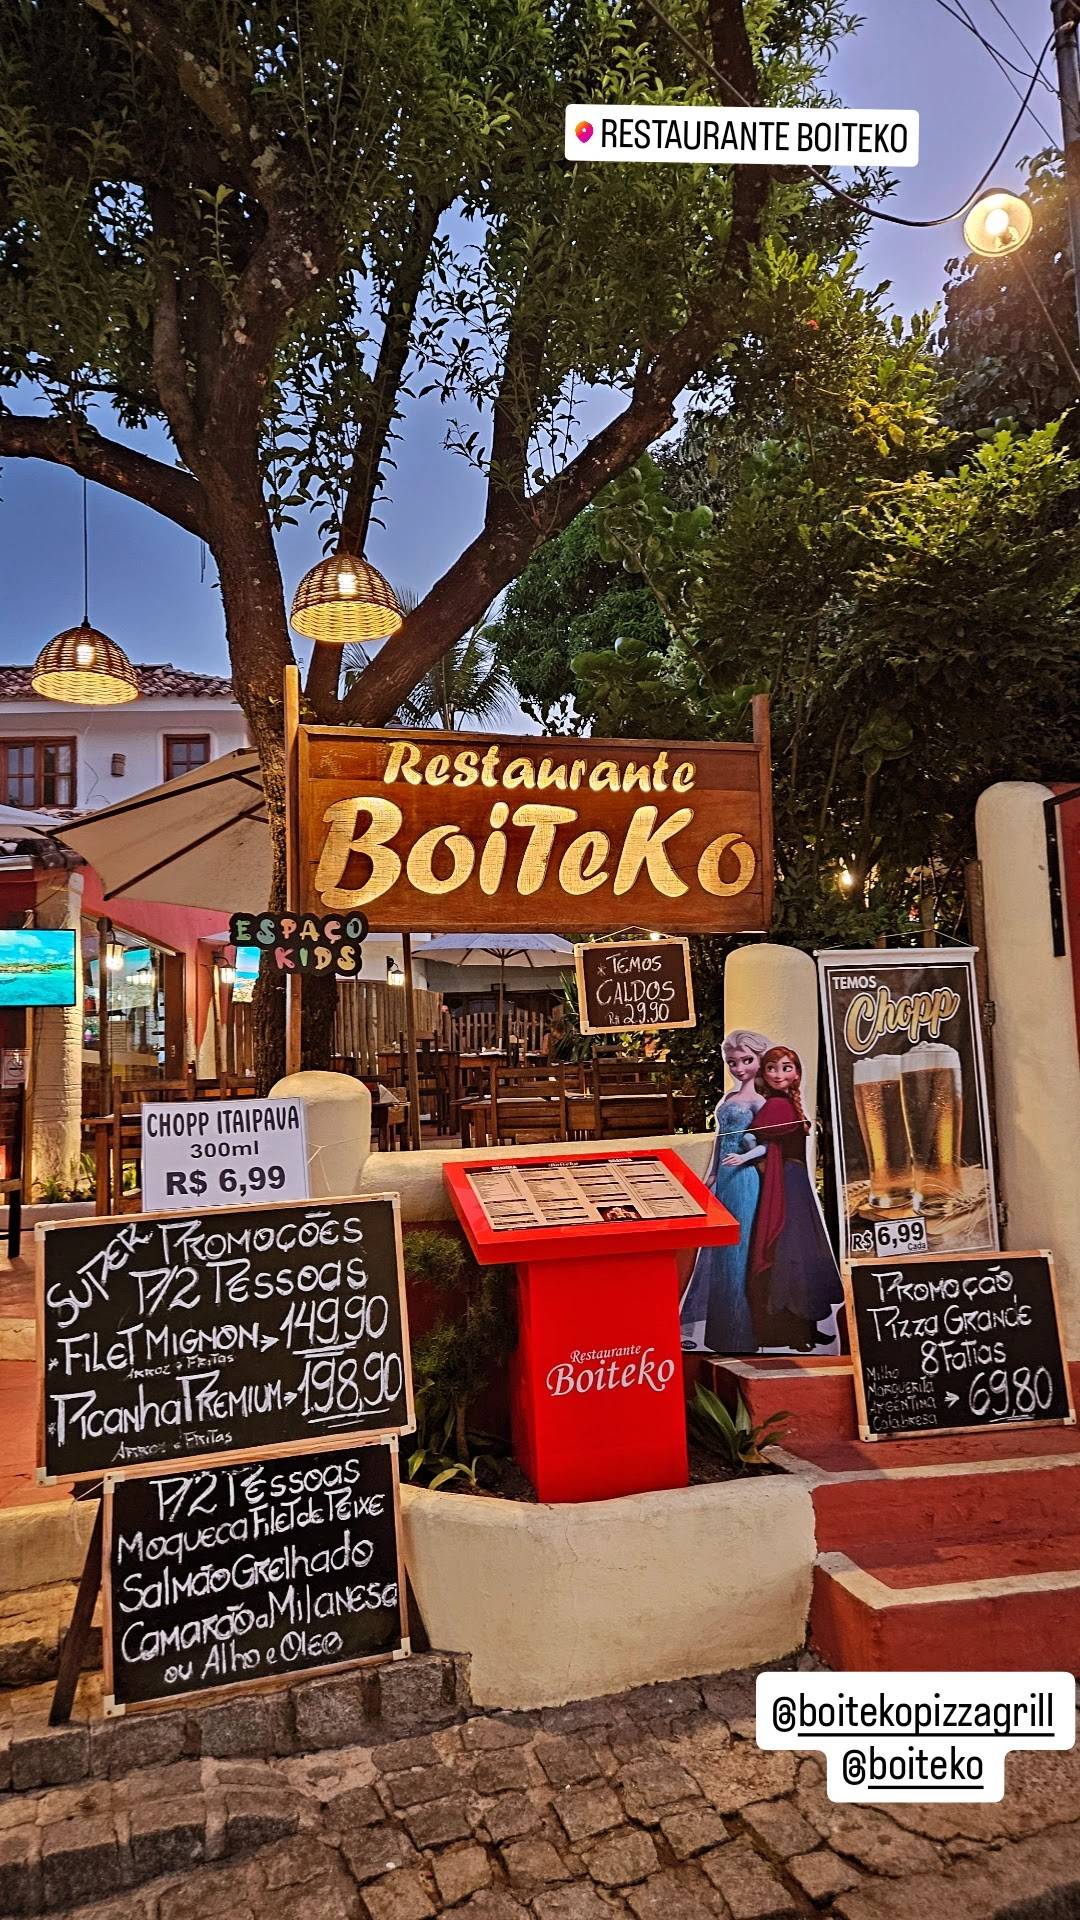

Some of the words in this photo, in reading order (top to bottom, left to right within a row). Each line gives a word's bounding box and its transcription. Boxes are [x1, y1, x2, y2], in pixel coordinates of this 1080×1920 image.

[384, 741, 697, 793] Restaurante
[235, 917, 363, 945] ESPAÇO
[274, 945, 356, 971] KIDS
[605, 953, 662, 973] TEMOS
[596, 978, 675, 1005] CALDOS
[832, 975, 877, 990] TEMOS
[623, 1001, 670, 1024] 29.90
[844, 986, 961, 1055] Chopp
[147, 1112, 209, 1137] CHOPP
[217, 1105, 300, 1135] ITAIPAVA
[190, 1140, 259, 1158] 300ml
[166, 1169, 208, 1197] R$
[219, 1165, 286, 1197] 6,99
[852, 1230, 873, 1252] R$
[877, 1222, 924, 1249] 6,99
[907, 1242, 927, 1251] Cada
[46, 1223, 154, 1328] SUPER
[570, 1345, 642, 1363] Restaurante
[921, 1340, 939, 1376] 8
[546, 1348, 675, 1396] Boiteko
[201, 1640, 260, 1680] Alho
[266, 1648, 278, 1665] e
